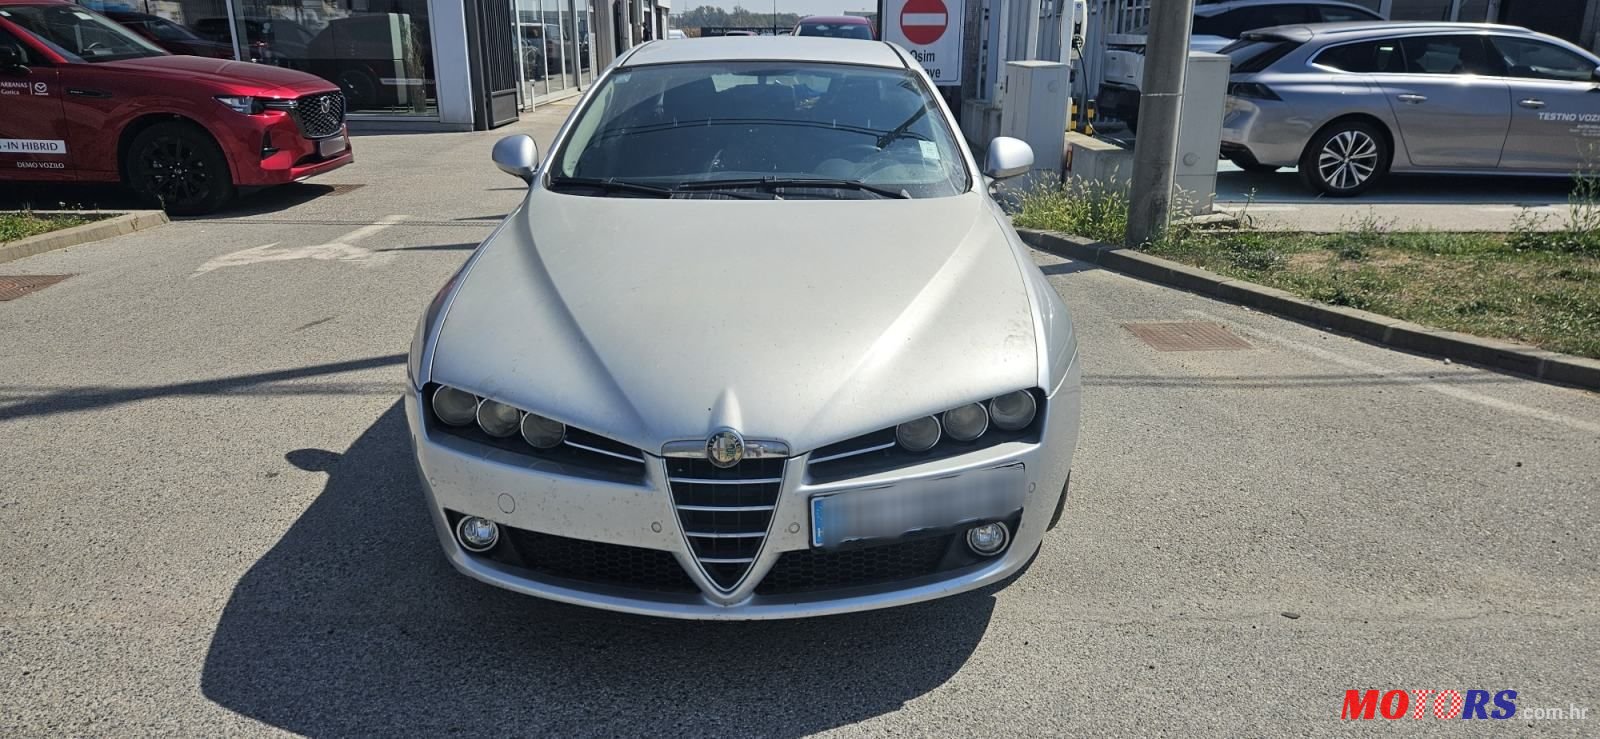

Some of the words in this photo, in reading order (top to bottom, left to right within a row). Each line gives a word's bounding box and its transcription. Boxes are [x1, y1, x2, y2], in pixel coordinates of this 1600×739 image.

[910, 49, 935, 62] Osim
[1538, 112, 1577, 122] TESTNO
[21, 142, 58, 151] HIBRID
[16, 161, 38, 169] DEMO
